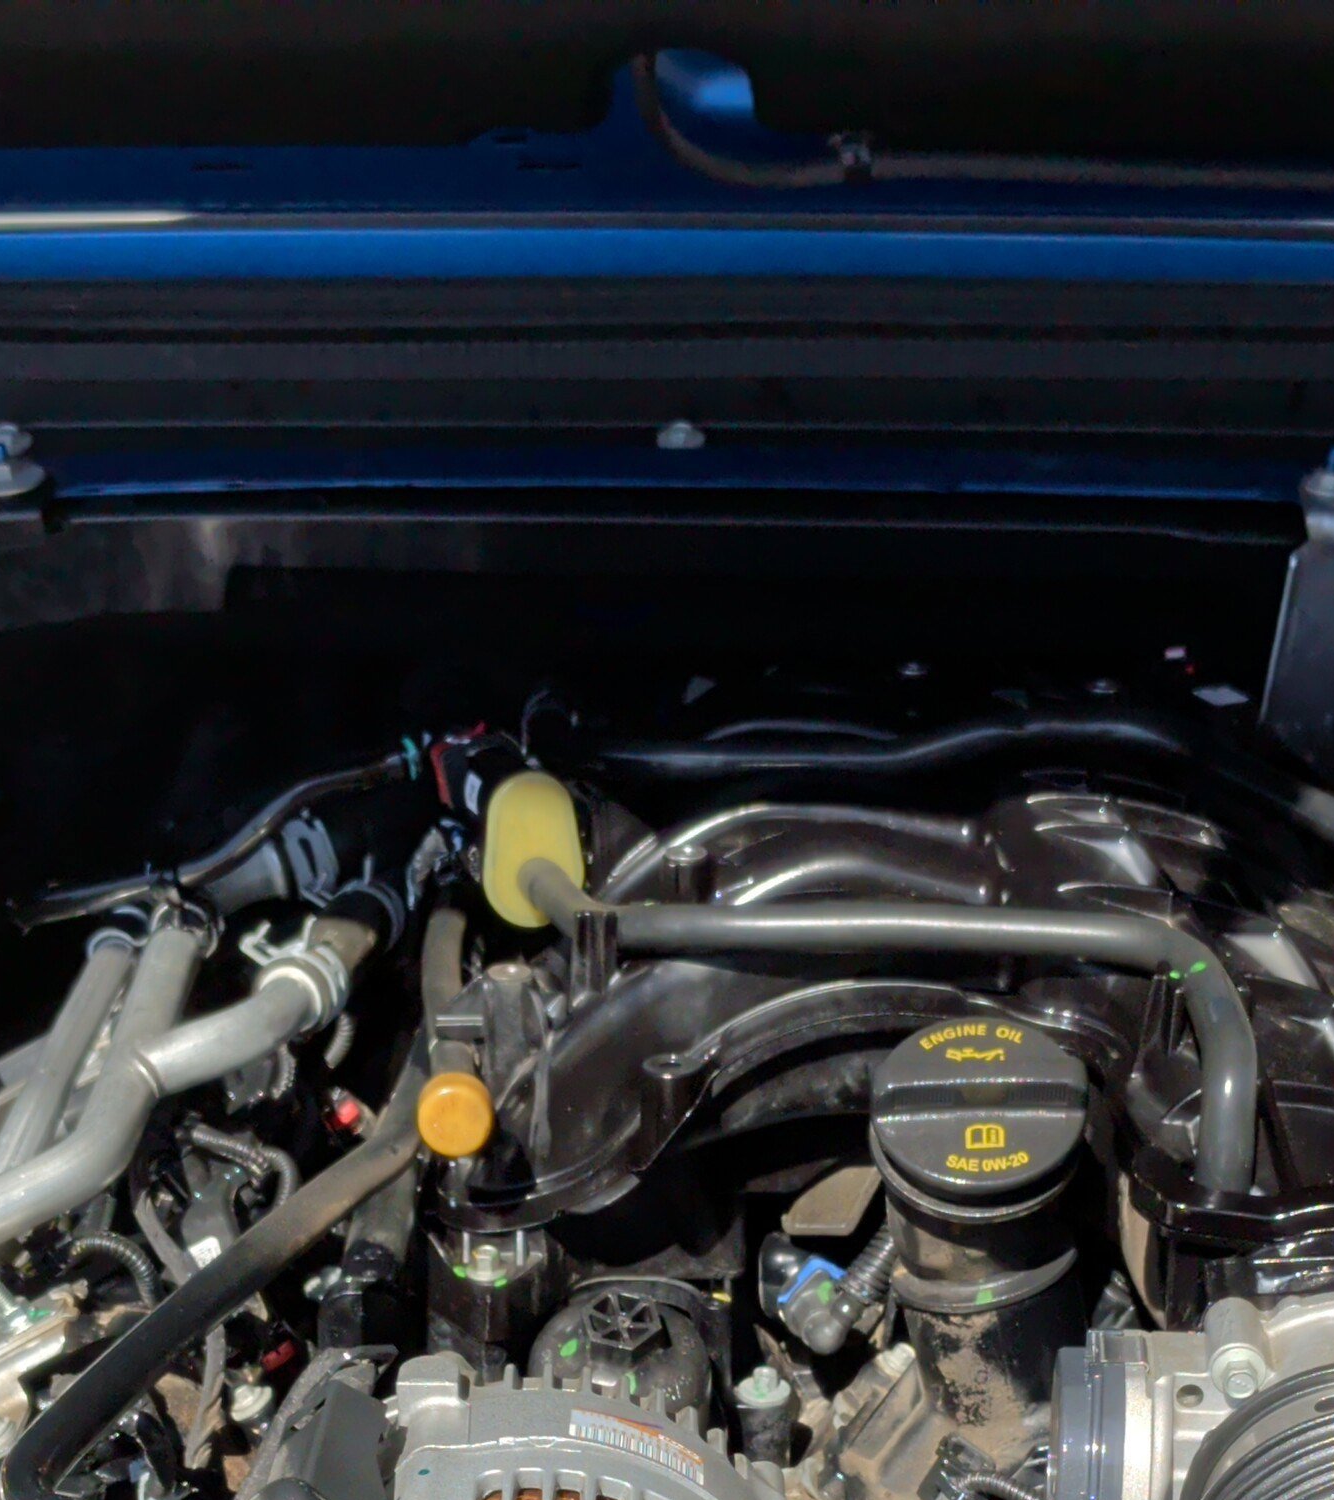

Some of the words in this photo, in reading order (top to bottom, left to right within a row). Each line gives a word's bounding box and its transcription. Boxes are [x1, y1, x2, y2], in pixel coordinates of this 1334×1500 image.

[919, 1023, 988, 1050] ENGINE
[995, 1026, 1025, 1044] OIL
[946, 1153, 980, 1172] SAE
[982, 1151, 1030, 1172] 0W-20
